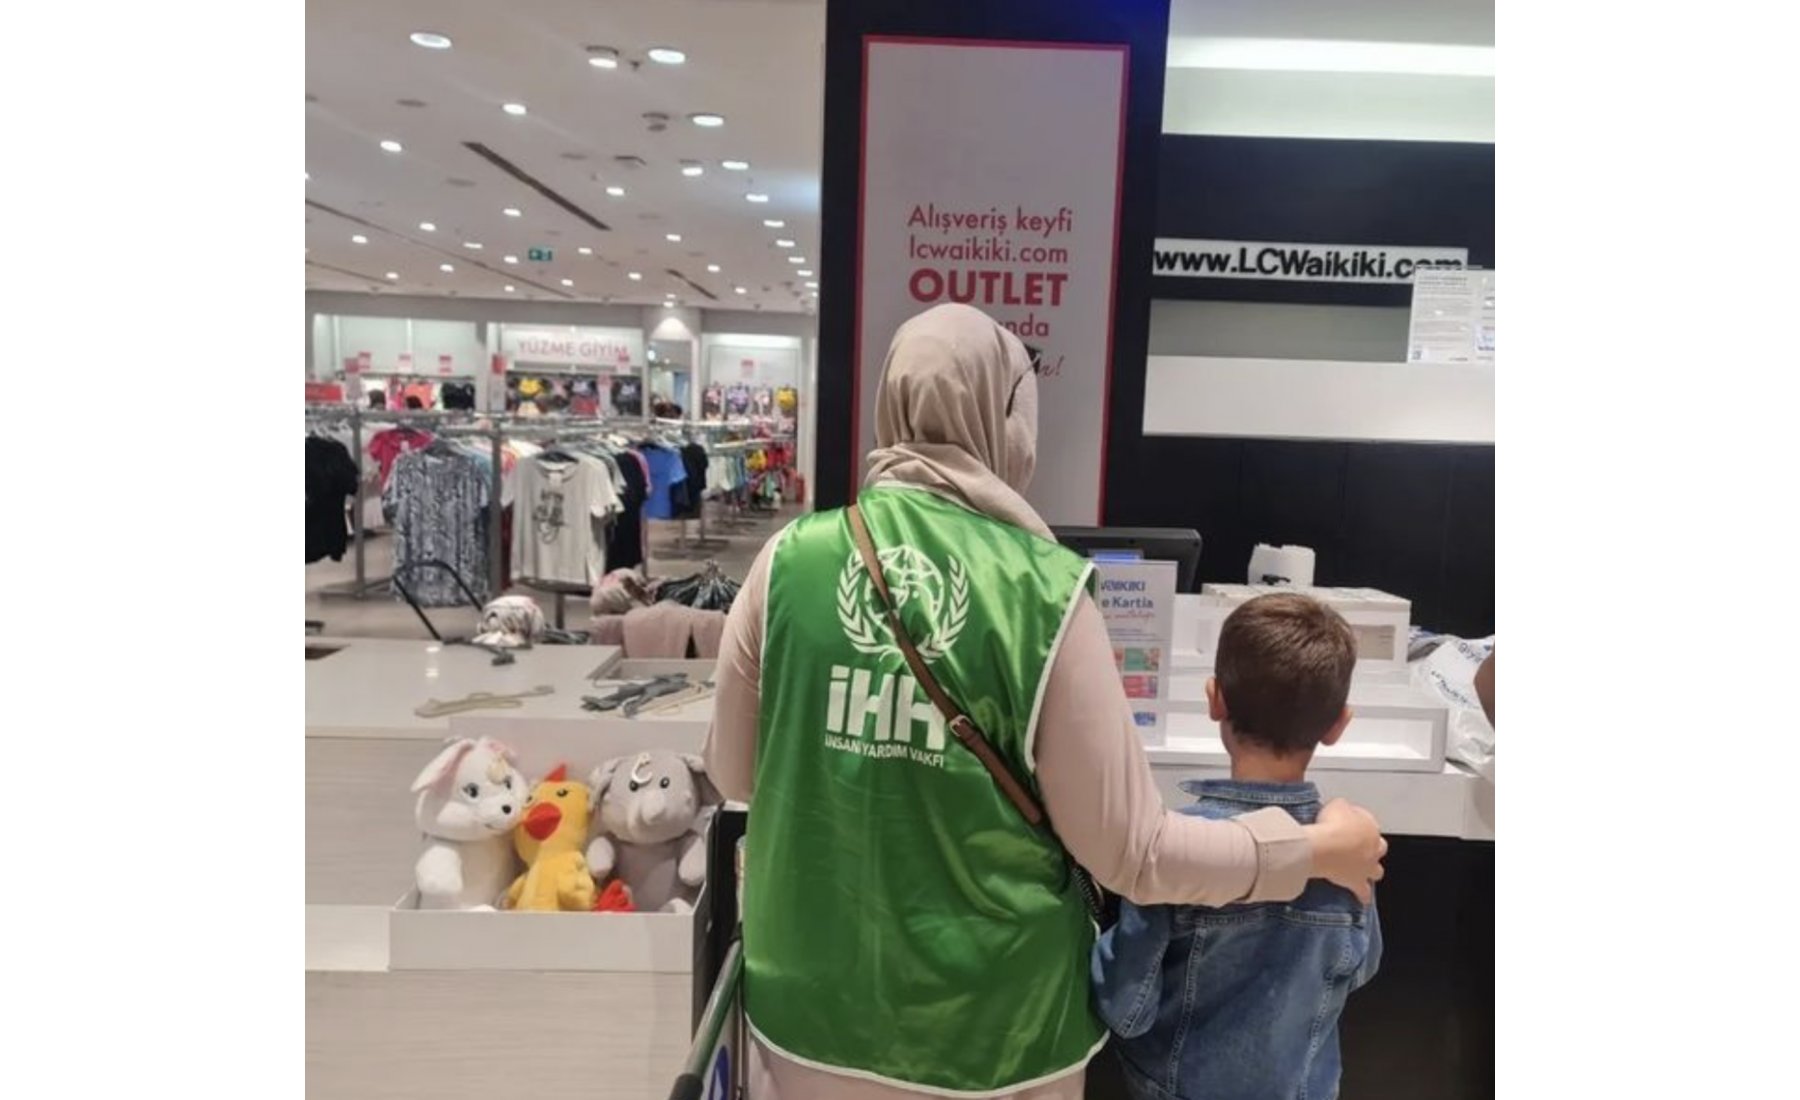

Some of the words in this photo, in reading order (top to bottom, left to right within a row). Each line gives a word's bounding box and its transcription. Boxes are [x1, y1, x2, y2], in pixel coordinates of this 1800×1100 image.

[908, 204, 1007, 236] Alışveriş
[1016, 206, 1073, 238] keyfi
[909, 236, 1069, 264] lcwaikiki.com
[908, 267, 1069, 307] OUTLET
[998, 312, 1049, 337] nda
[517, 336, 575, 357] YÜZME
